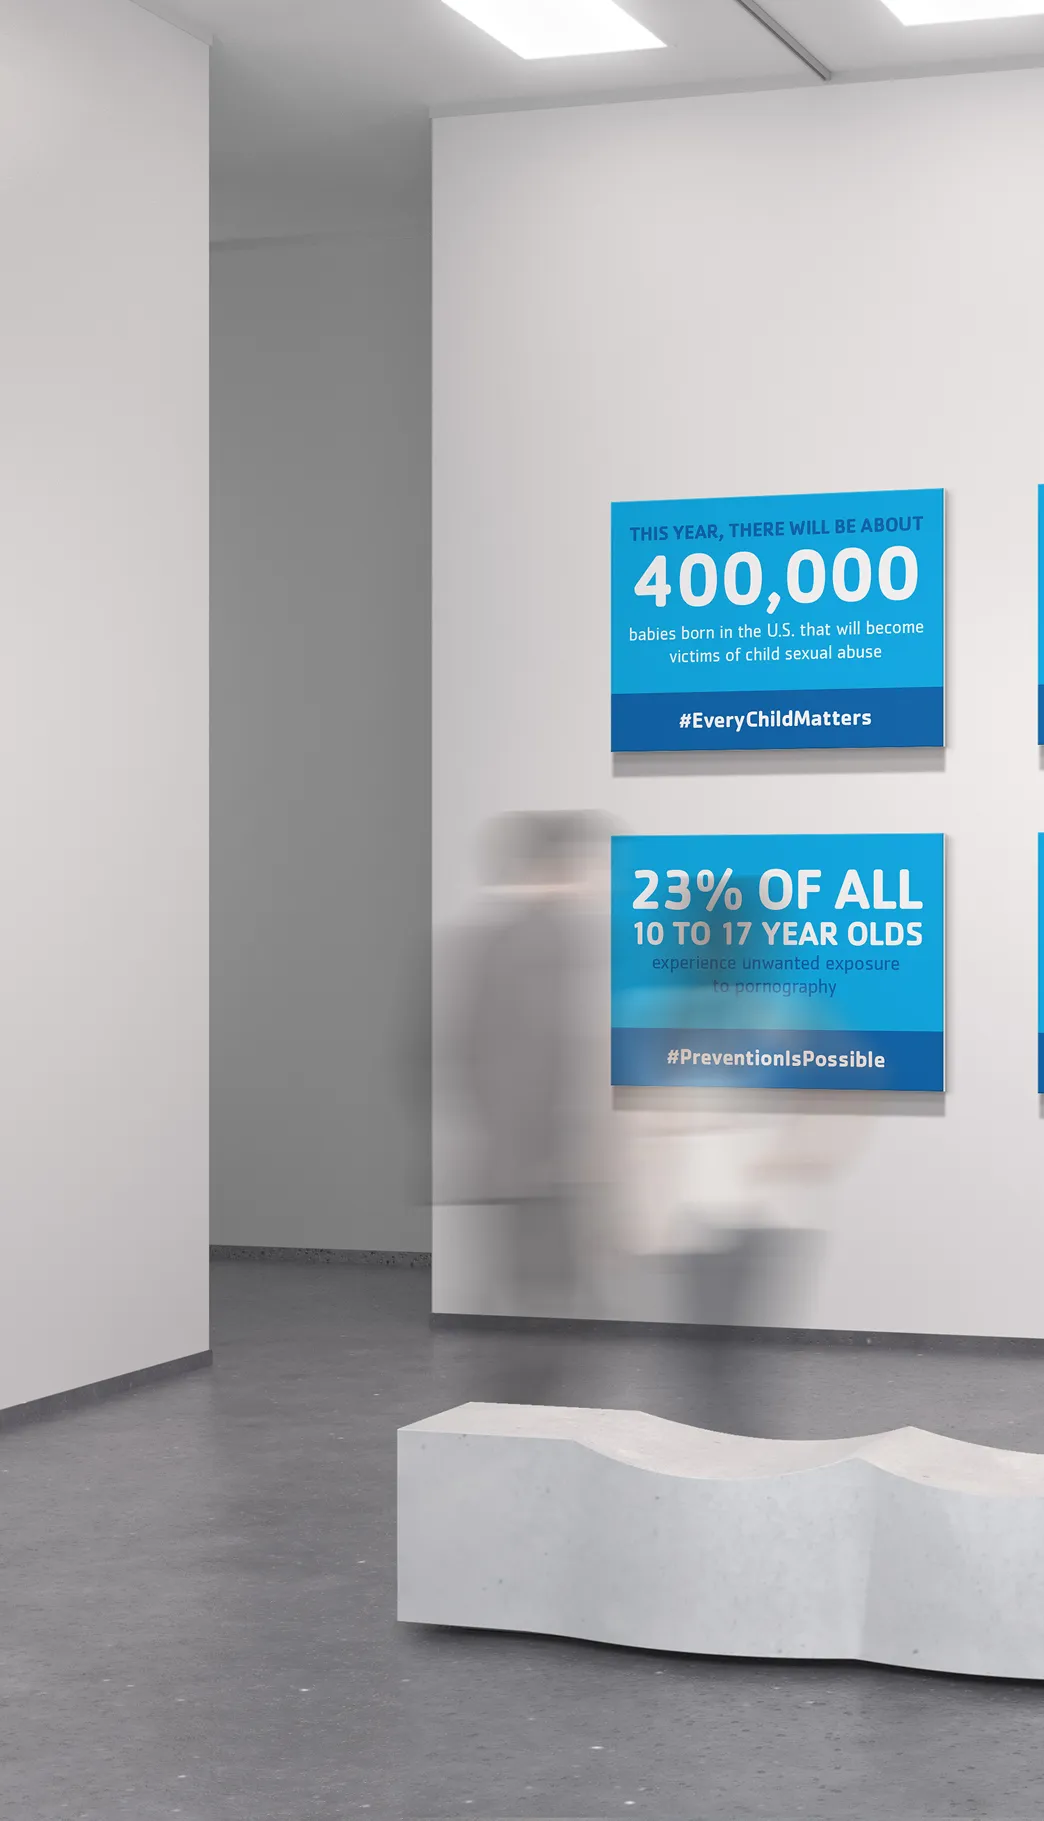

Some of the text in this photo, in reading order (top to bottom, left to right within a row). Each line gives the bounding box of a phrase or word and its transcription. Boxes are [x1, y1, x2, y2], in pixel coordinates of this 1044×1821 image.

[630, 516, 924, 541] THIS YEAR, THERE WILL BE ABOUT
[634, 545, 919, 615] 400,000
[629, 621, 924, 641] babies born in the U.S. that will become
[669, 645, 882, 663] victims of child sexual abuse
[679, 710, 872, 732] #EveryChildMatters
[632, 868, 923, 911] 23% OF ALL
[633, 921, 922, 946] 10 TO 17 YEAR OLDS
[652, 955, 900, 974] experience unwanted exposure
[713, 979, 837, 997] to pornography
[667, 1048, 885, 1068] #PreventionIsPossible
